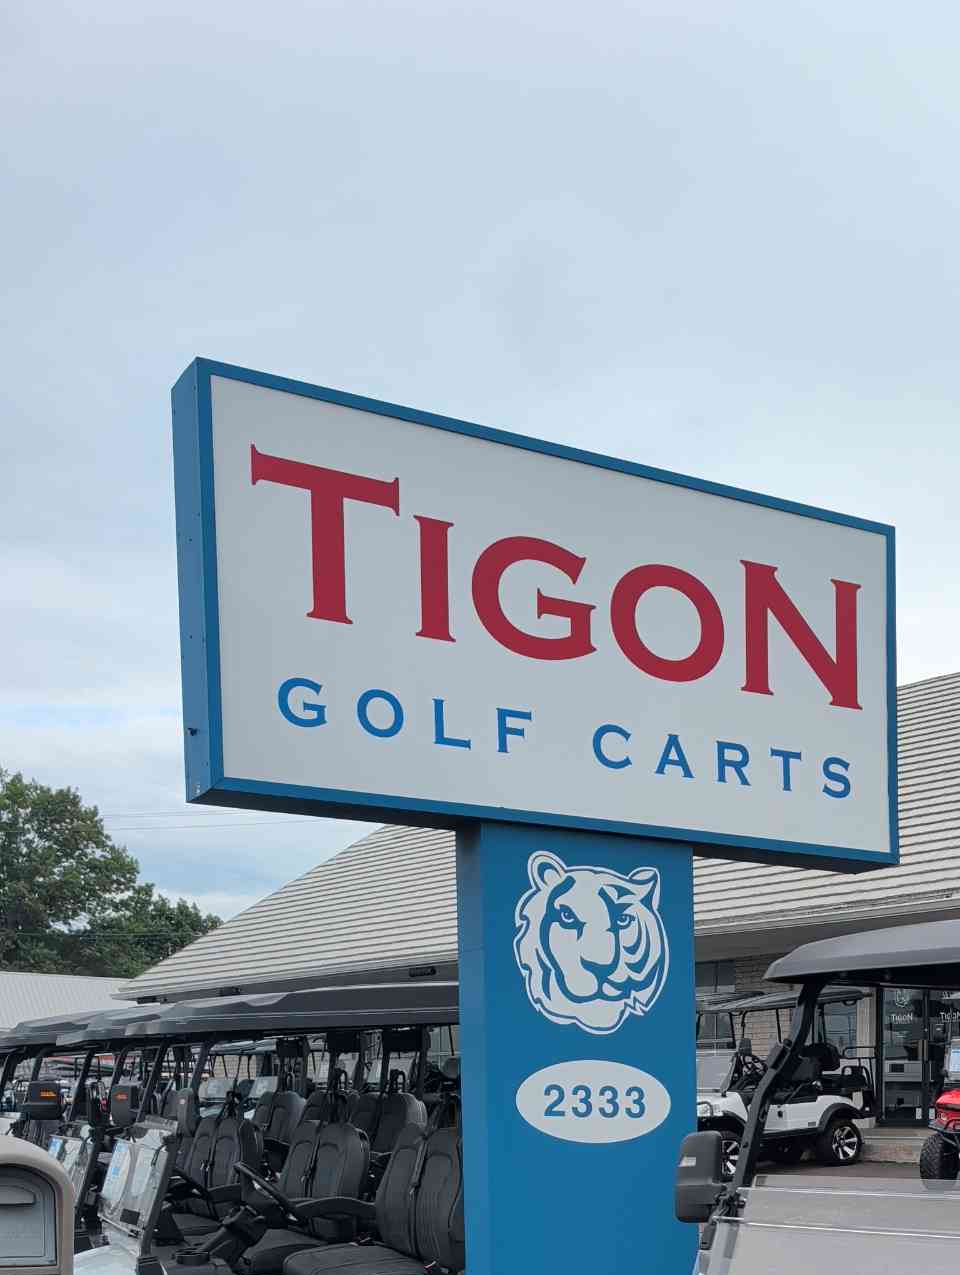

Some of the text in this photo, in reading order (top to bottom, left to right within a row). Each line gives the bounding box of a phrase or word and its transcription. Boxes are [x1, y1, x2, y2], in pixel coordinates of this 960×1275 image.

[250, 444, 863, 711] TIGON
[277, 677, 852, 799] GOLF CARTS
[543, 1083, 646, 1119] 2333
